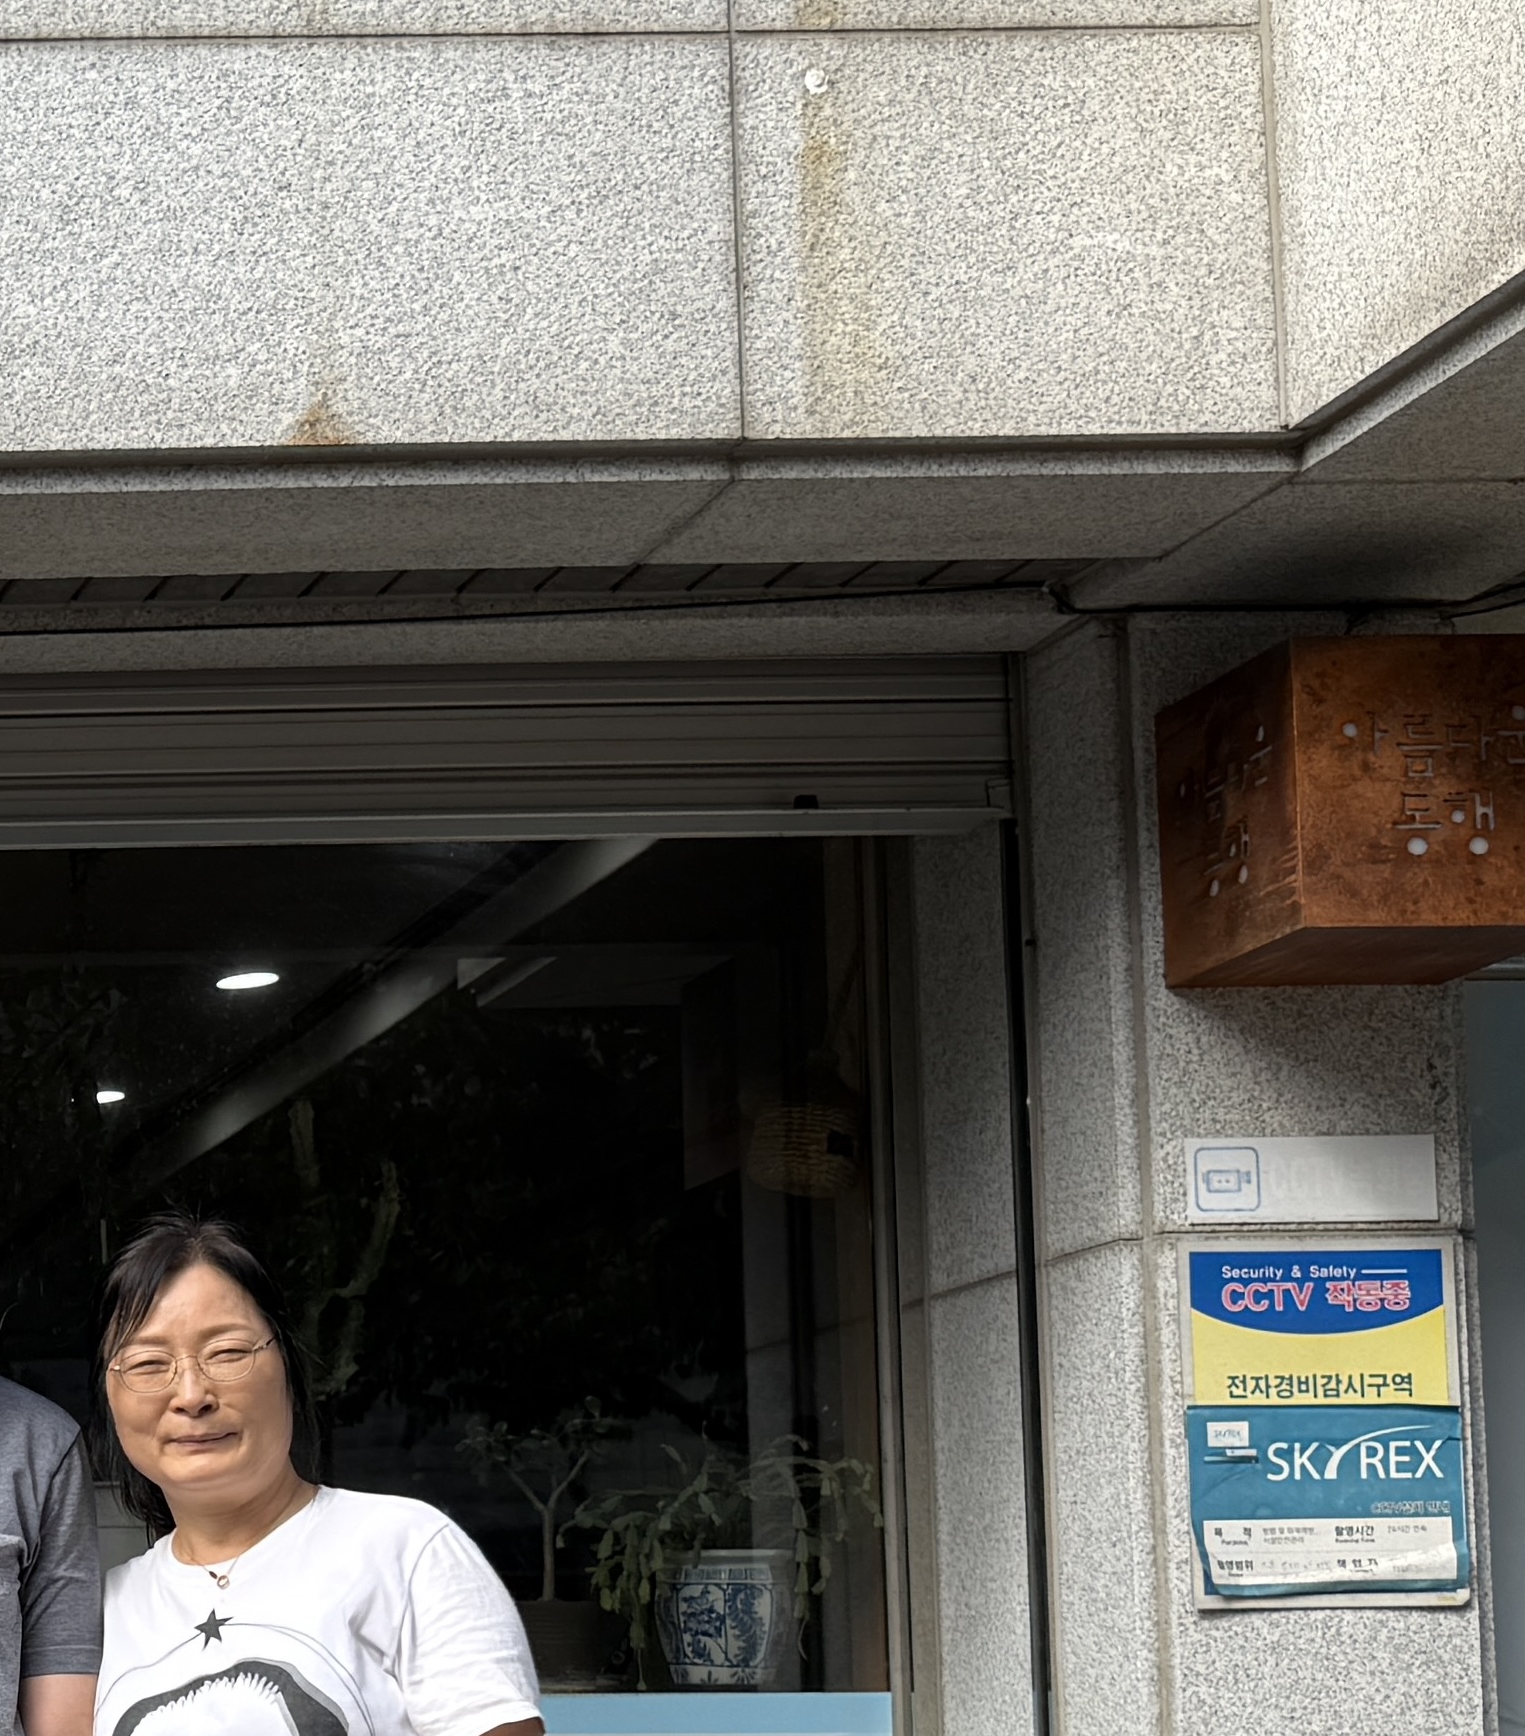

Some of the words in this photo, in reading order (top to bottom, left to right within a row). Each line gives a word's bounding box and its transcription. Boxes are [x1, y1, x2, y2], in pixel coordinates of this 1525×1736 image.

[1221, 1266, 1283, 1280] Security
[1291, 1266, 1302, 1278] &
[1310, 1266, 1357, 1279] Safety
[1221, 1282, 1314, 1312] CCTV
[1325, 1280, 1411, 1312] 작동중
[1227, 1373, 1413, 1399] 전자경비감시구역
[1267, 1430, 1445, 1481] SKYREX
